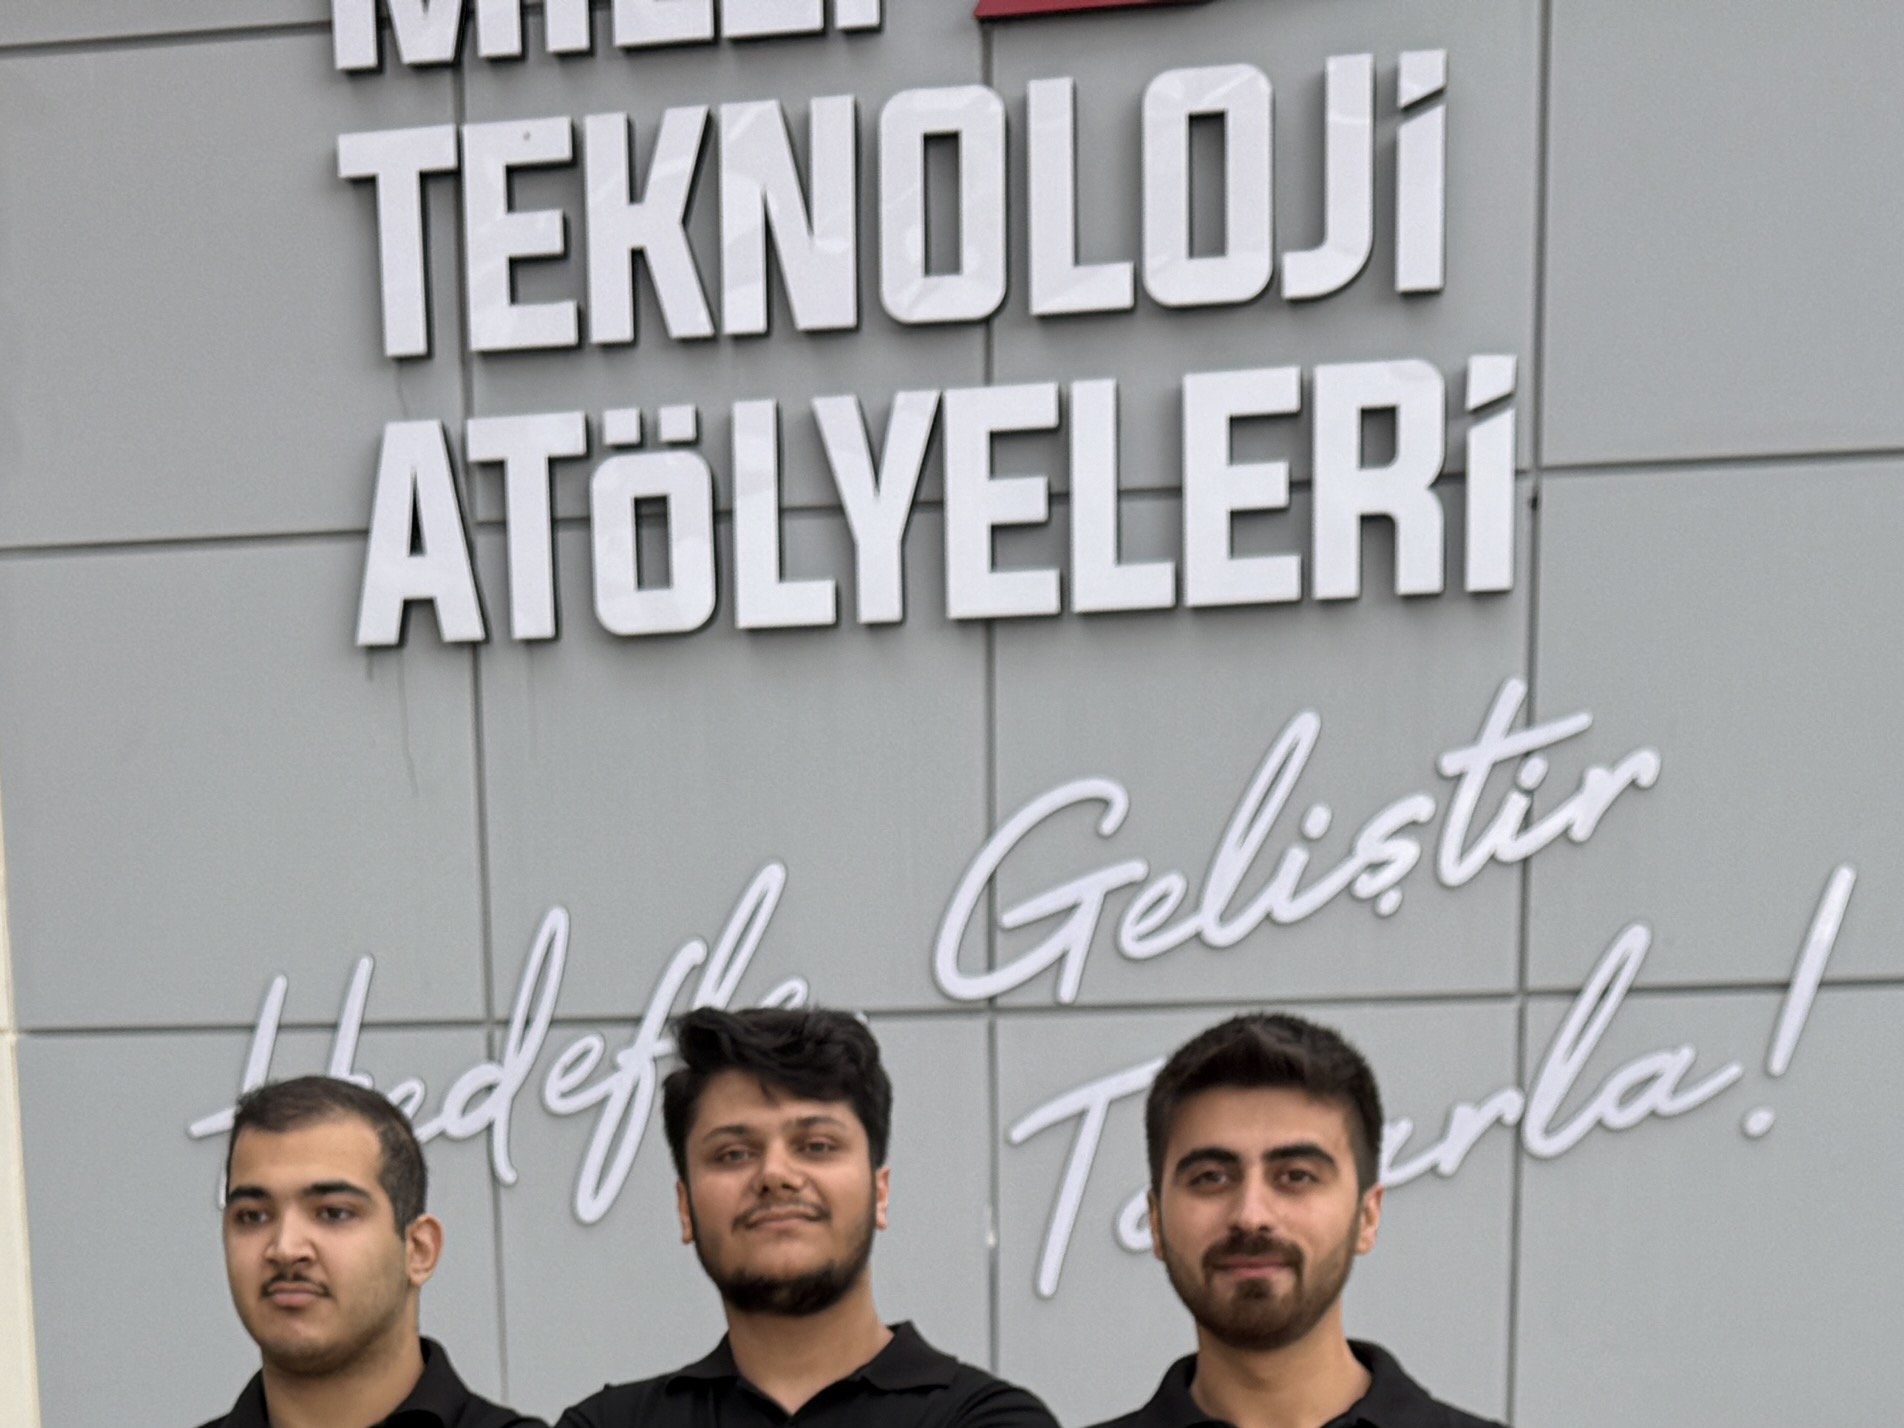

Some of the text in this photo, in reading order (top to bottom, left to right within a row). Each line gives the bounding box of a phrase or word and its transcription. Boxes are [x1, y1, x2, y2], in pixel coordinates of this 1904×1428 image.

[337, 47, 1447, 360] TEKNOLOJİ
[357, 354, 1518, 647] ATÖLYELERİ
[932, 679, 1661, 1003] Geliştir
